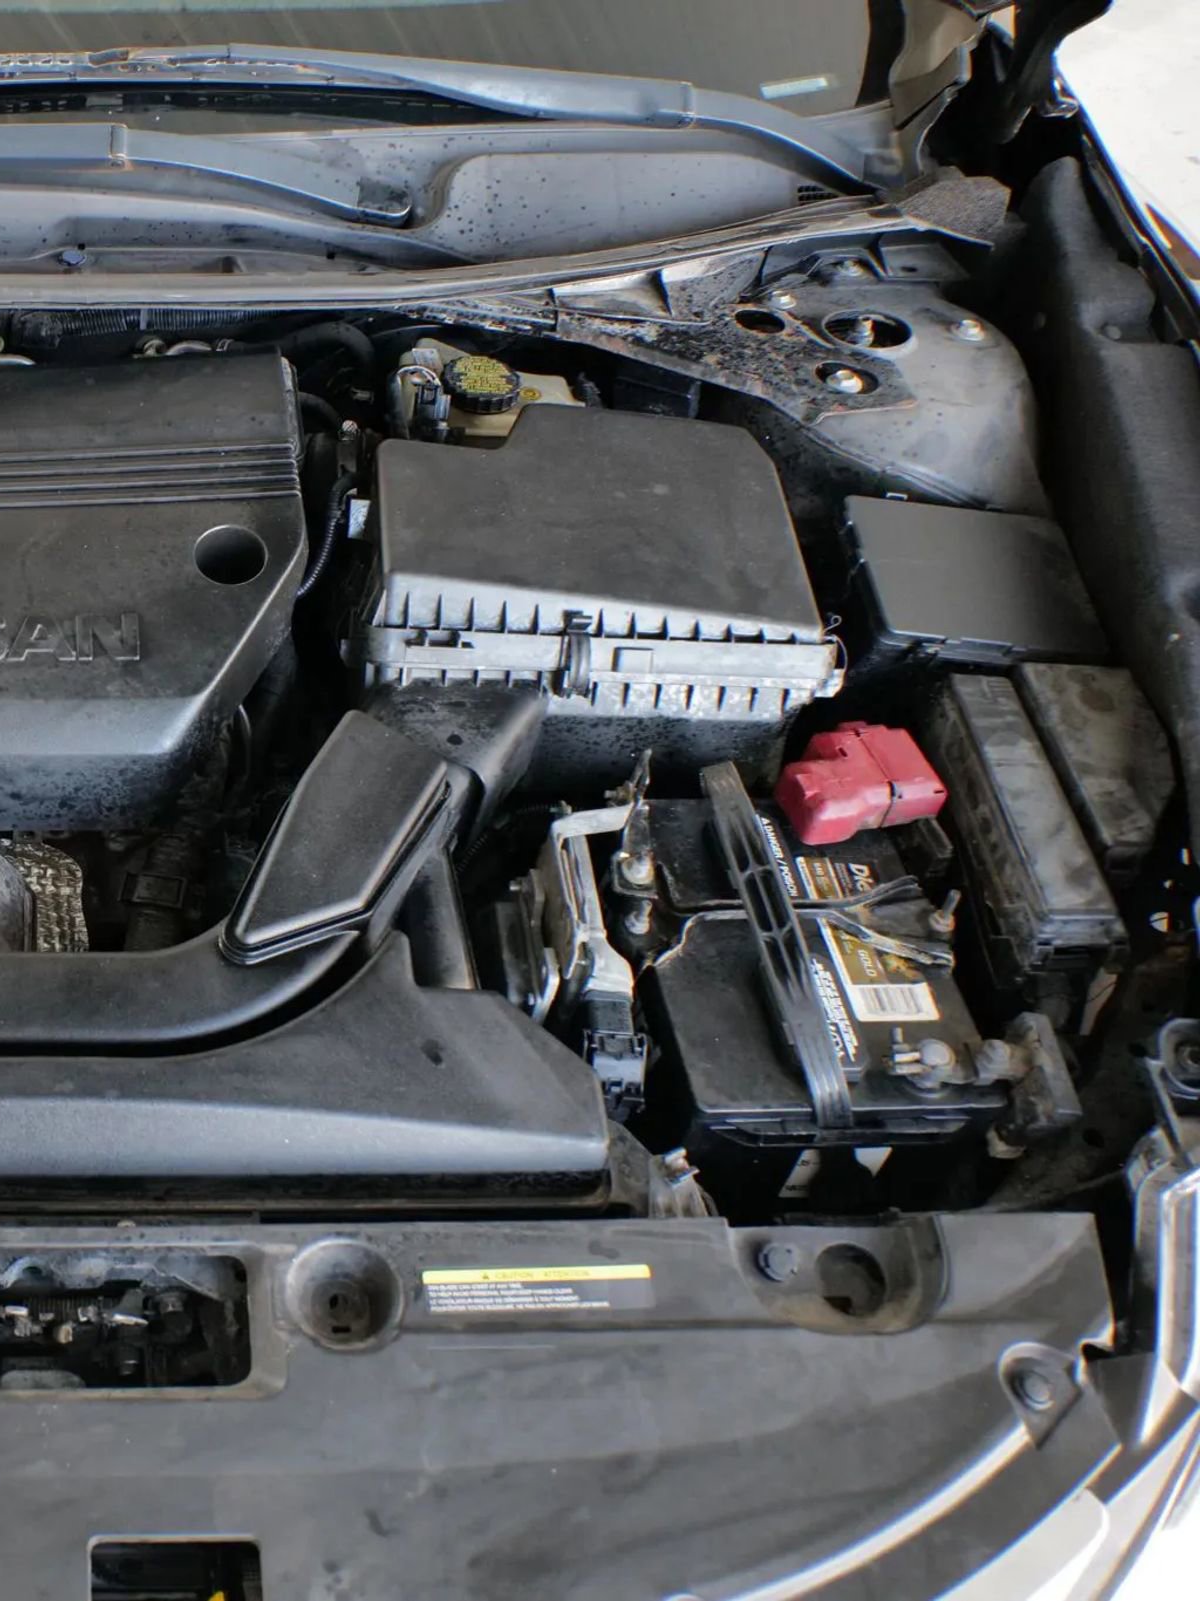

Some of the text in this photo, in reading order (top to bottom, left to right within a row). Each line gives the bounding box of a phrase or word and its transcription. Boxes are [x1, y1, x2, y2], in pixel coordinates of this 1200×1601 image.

[764, 825, 785, 861] DANGER
[779, 865, 799, 897] POISON
[857, 949, 877, 978] GOLD
